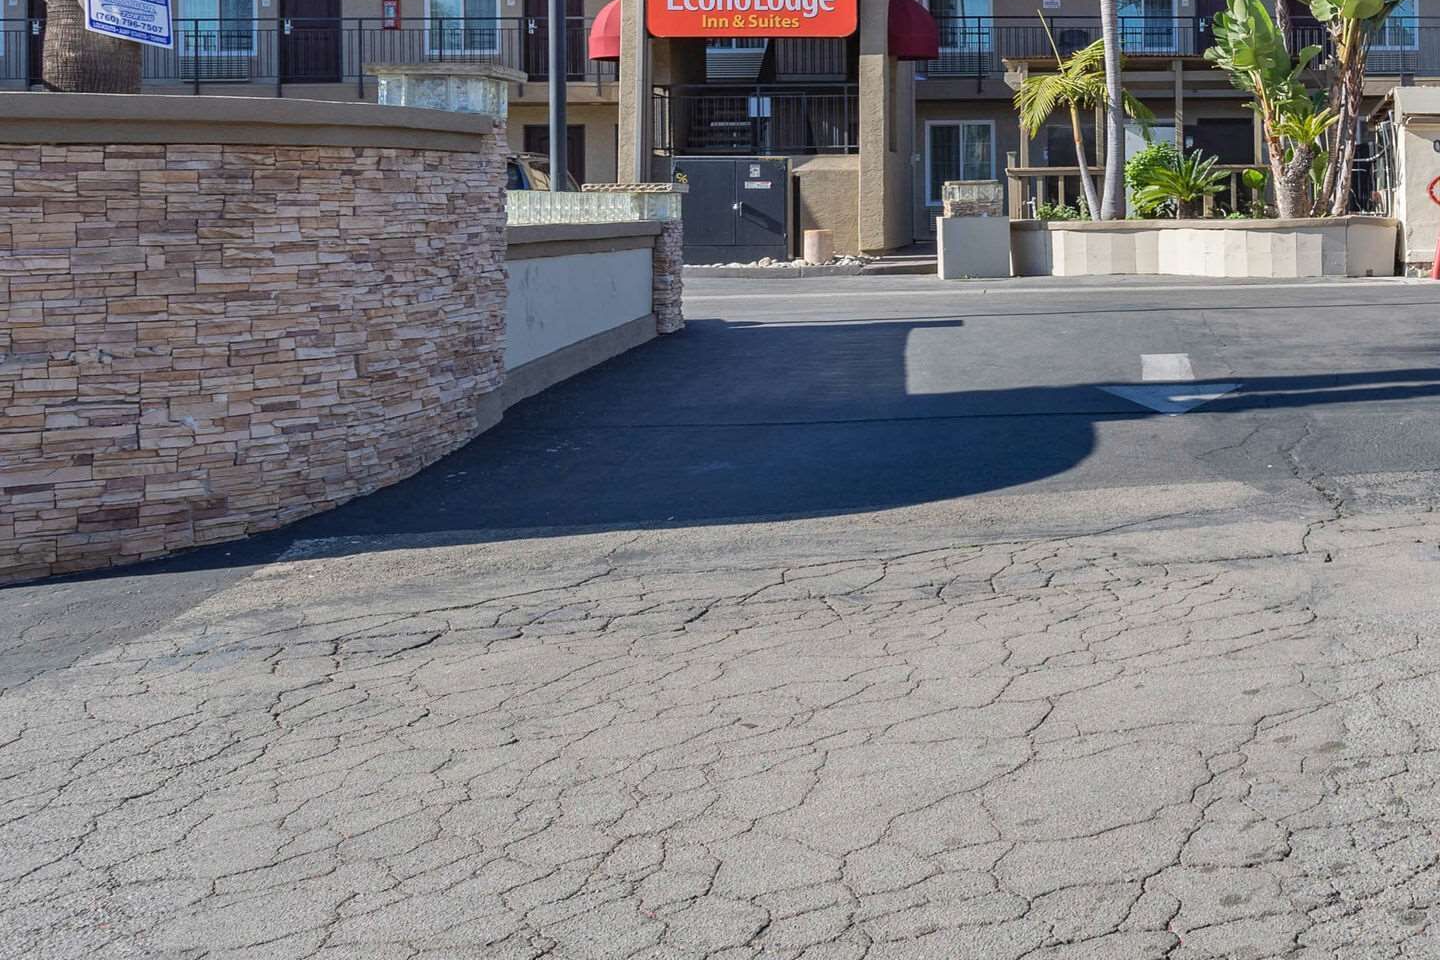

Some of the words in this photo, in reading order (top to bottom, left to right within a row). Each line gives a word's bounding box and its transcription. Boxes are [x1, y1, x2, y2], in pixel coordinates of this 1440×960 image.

[96, 12, 118, 26] (760)
[122, 18, 163, 33] 796-7507
[702, 14, 728, 28] Inn
[733, 14, 745, 28] &
[748, 13, 800, 28] Suites
